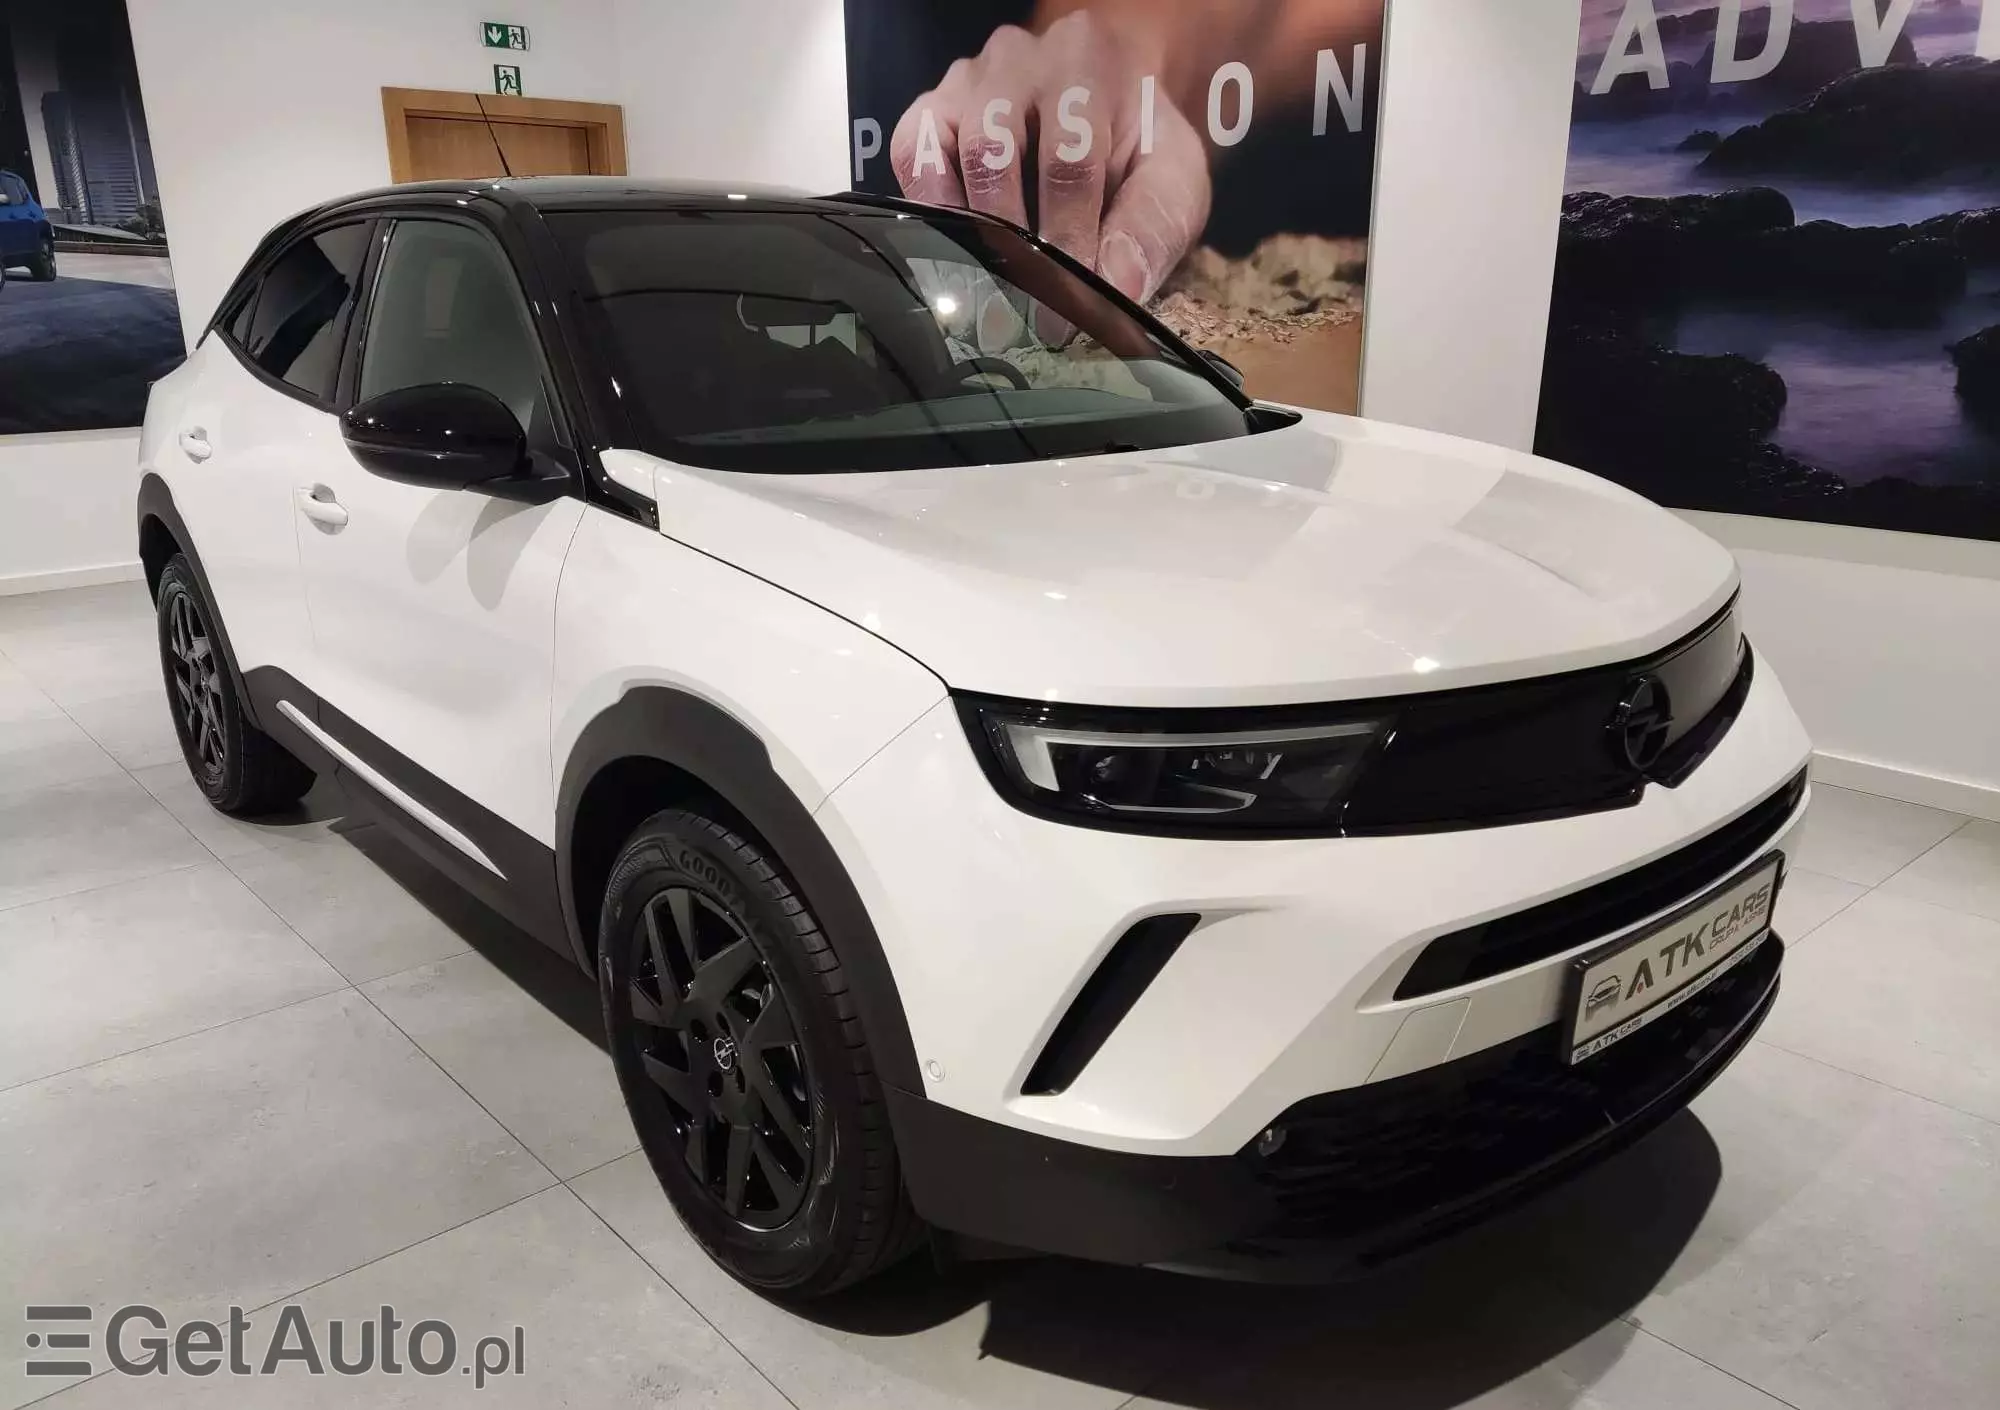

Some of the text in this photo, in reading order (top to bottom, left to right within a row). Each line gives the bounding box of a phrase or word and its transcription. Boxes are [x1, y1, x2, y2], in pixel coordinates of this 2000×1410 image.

[854, 43, 1367, 183] PASSION
[1625, 922, 1710, 1001] ATK
[1711, 882, 1771, 938] CARS
